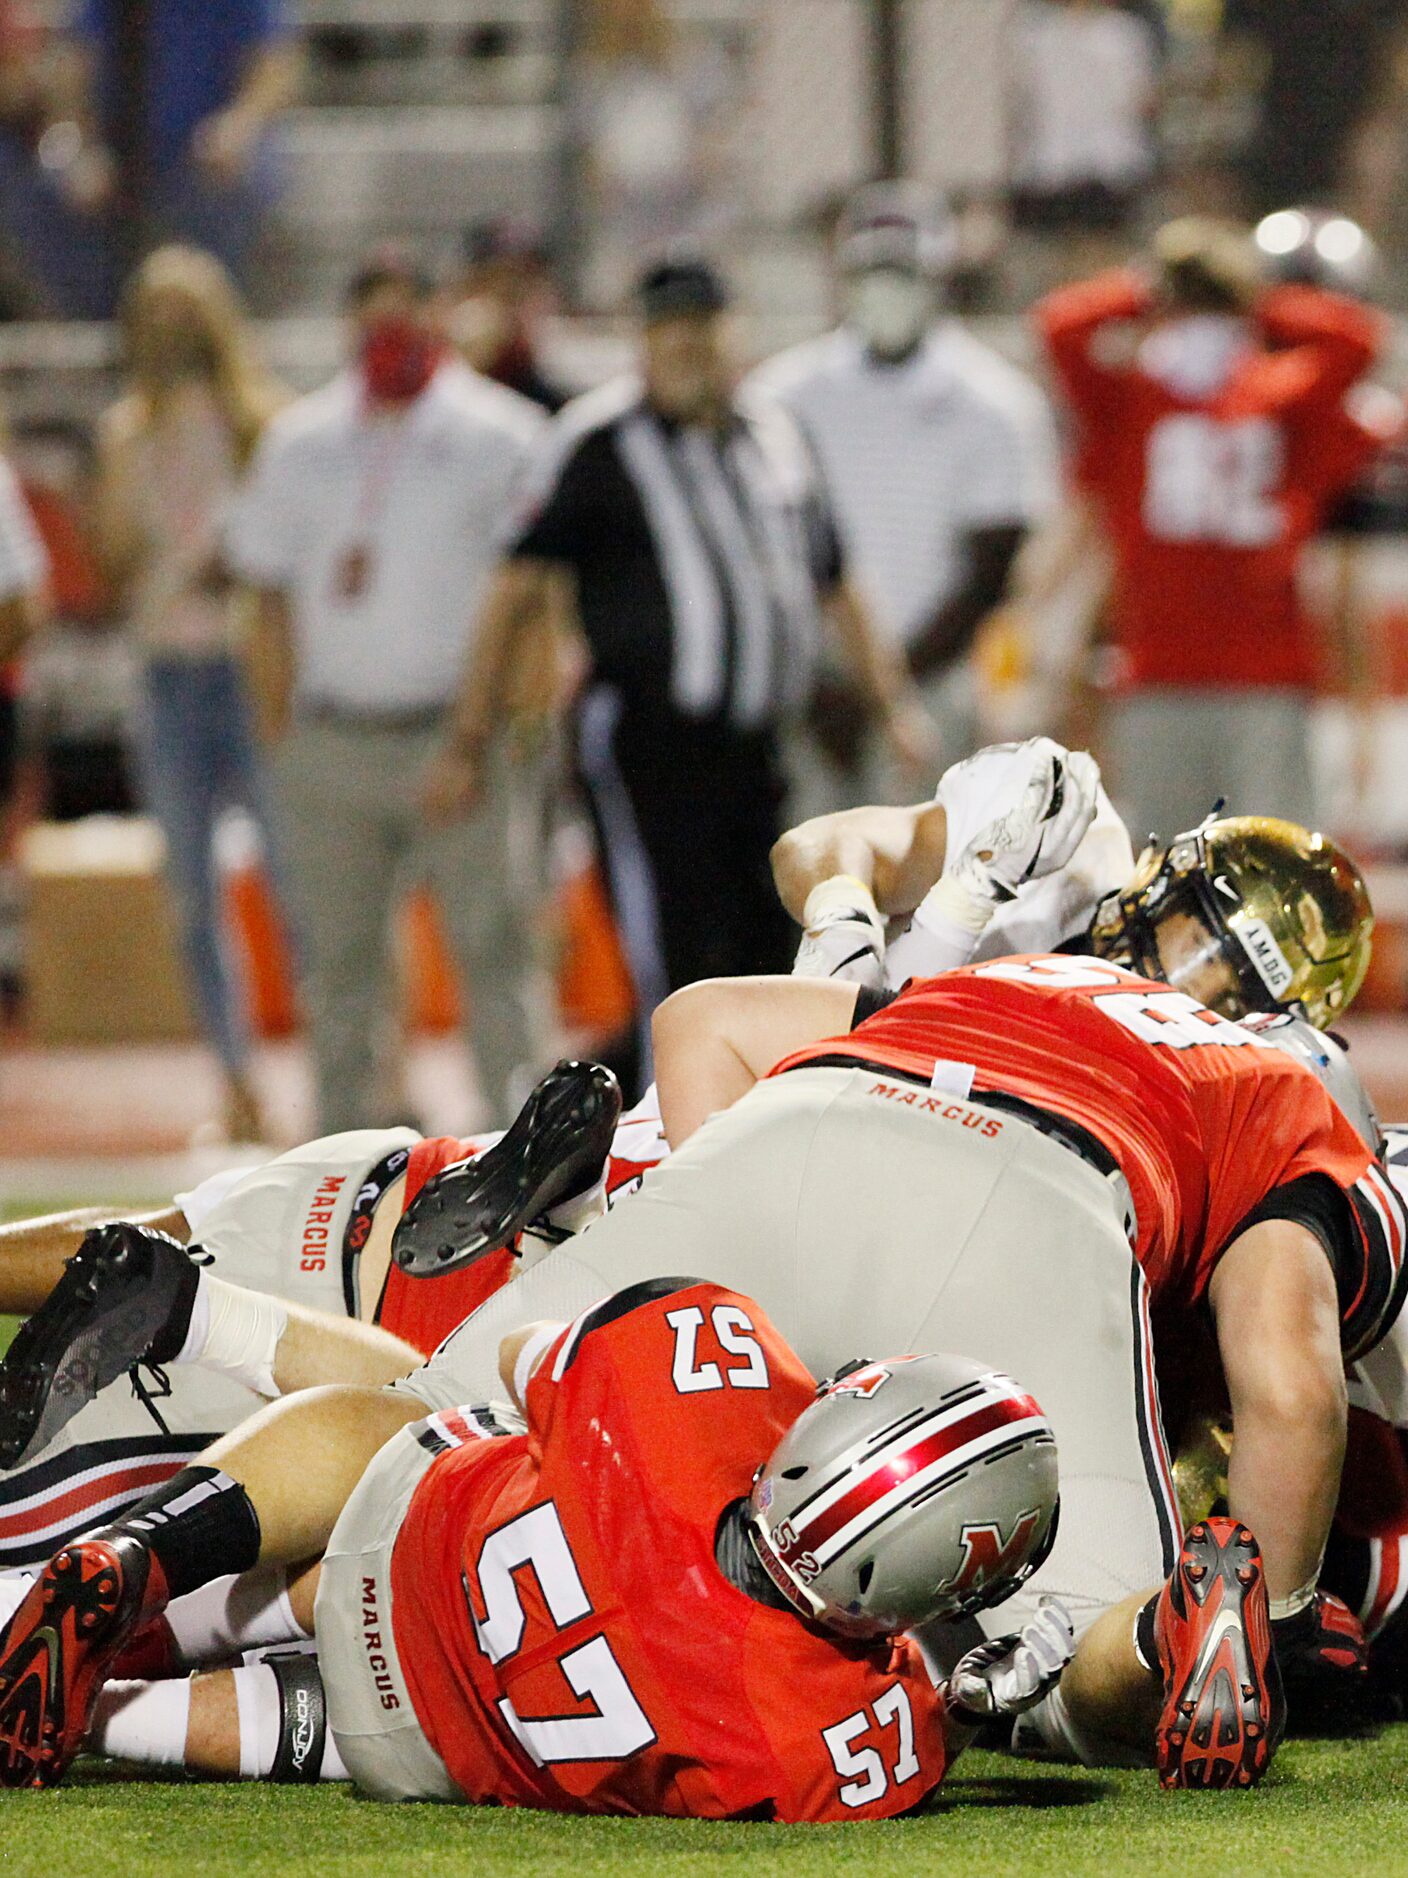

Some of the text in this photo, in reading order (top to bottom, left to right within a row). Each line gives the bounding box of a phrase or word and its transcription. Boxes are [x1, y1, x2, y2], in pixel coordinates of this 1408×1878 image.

[868, 1082, 1004, 1138] MARCUS
[299, 1175, 347, 1272] MARCUS
[666, 1304, 770, 1394] 57
[771, 1514, 824, 1587] 52
[361, 1576, 401, 1711] MARCUS
[462, 1497, 659, 1769] 57
[292, 1688, 309, 1771] DONJOY
[820, 1680, 921, 1809] 57
